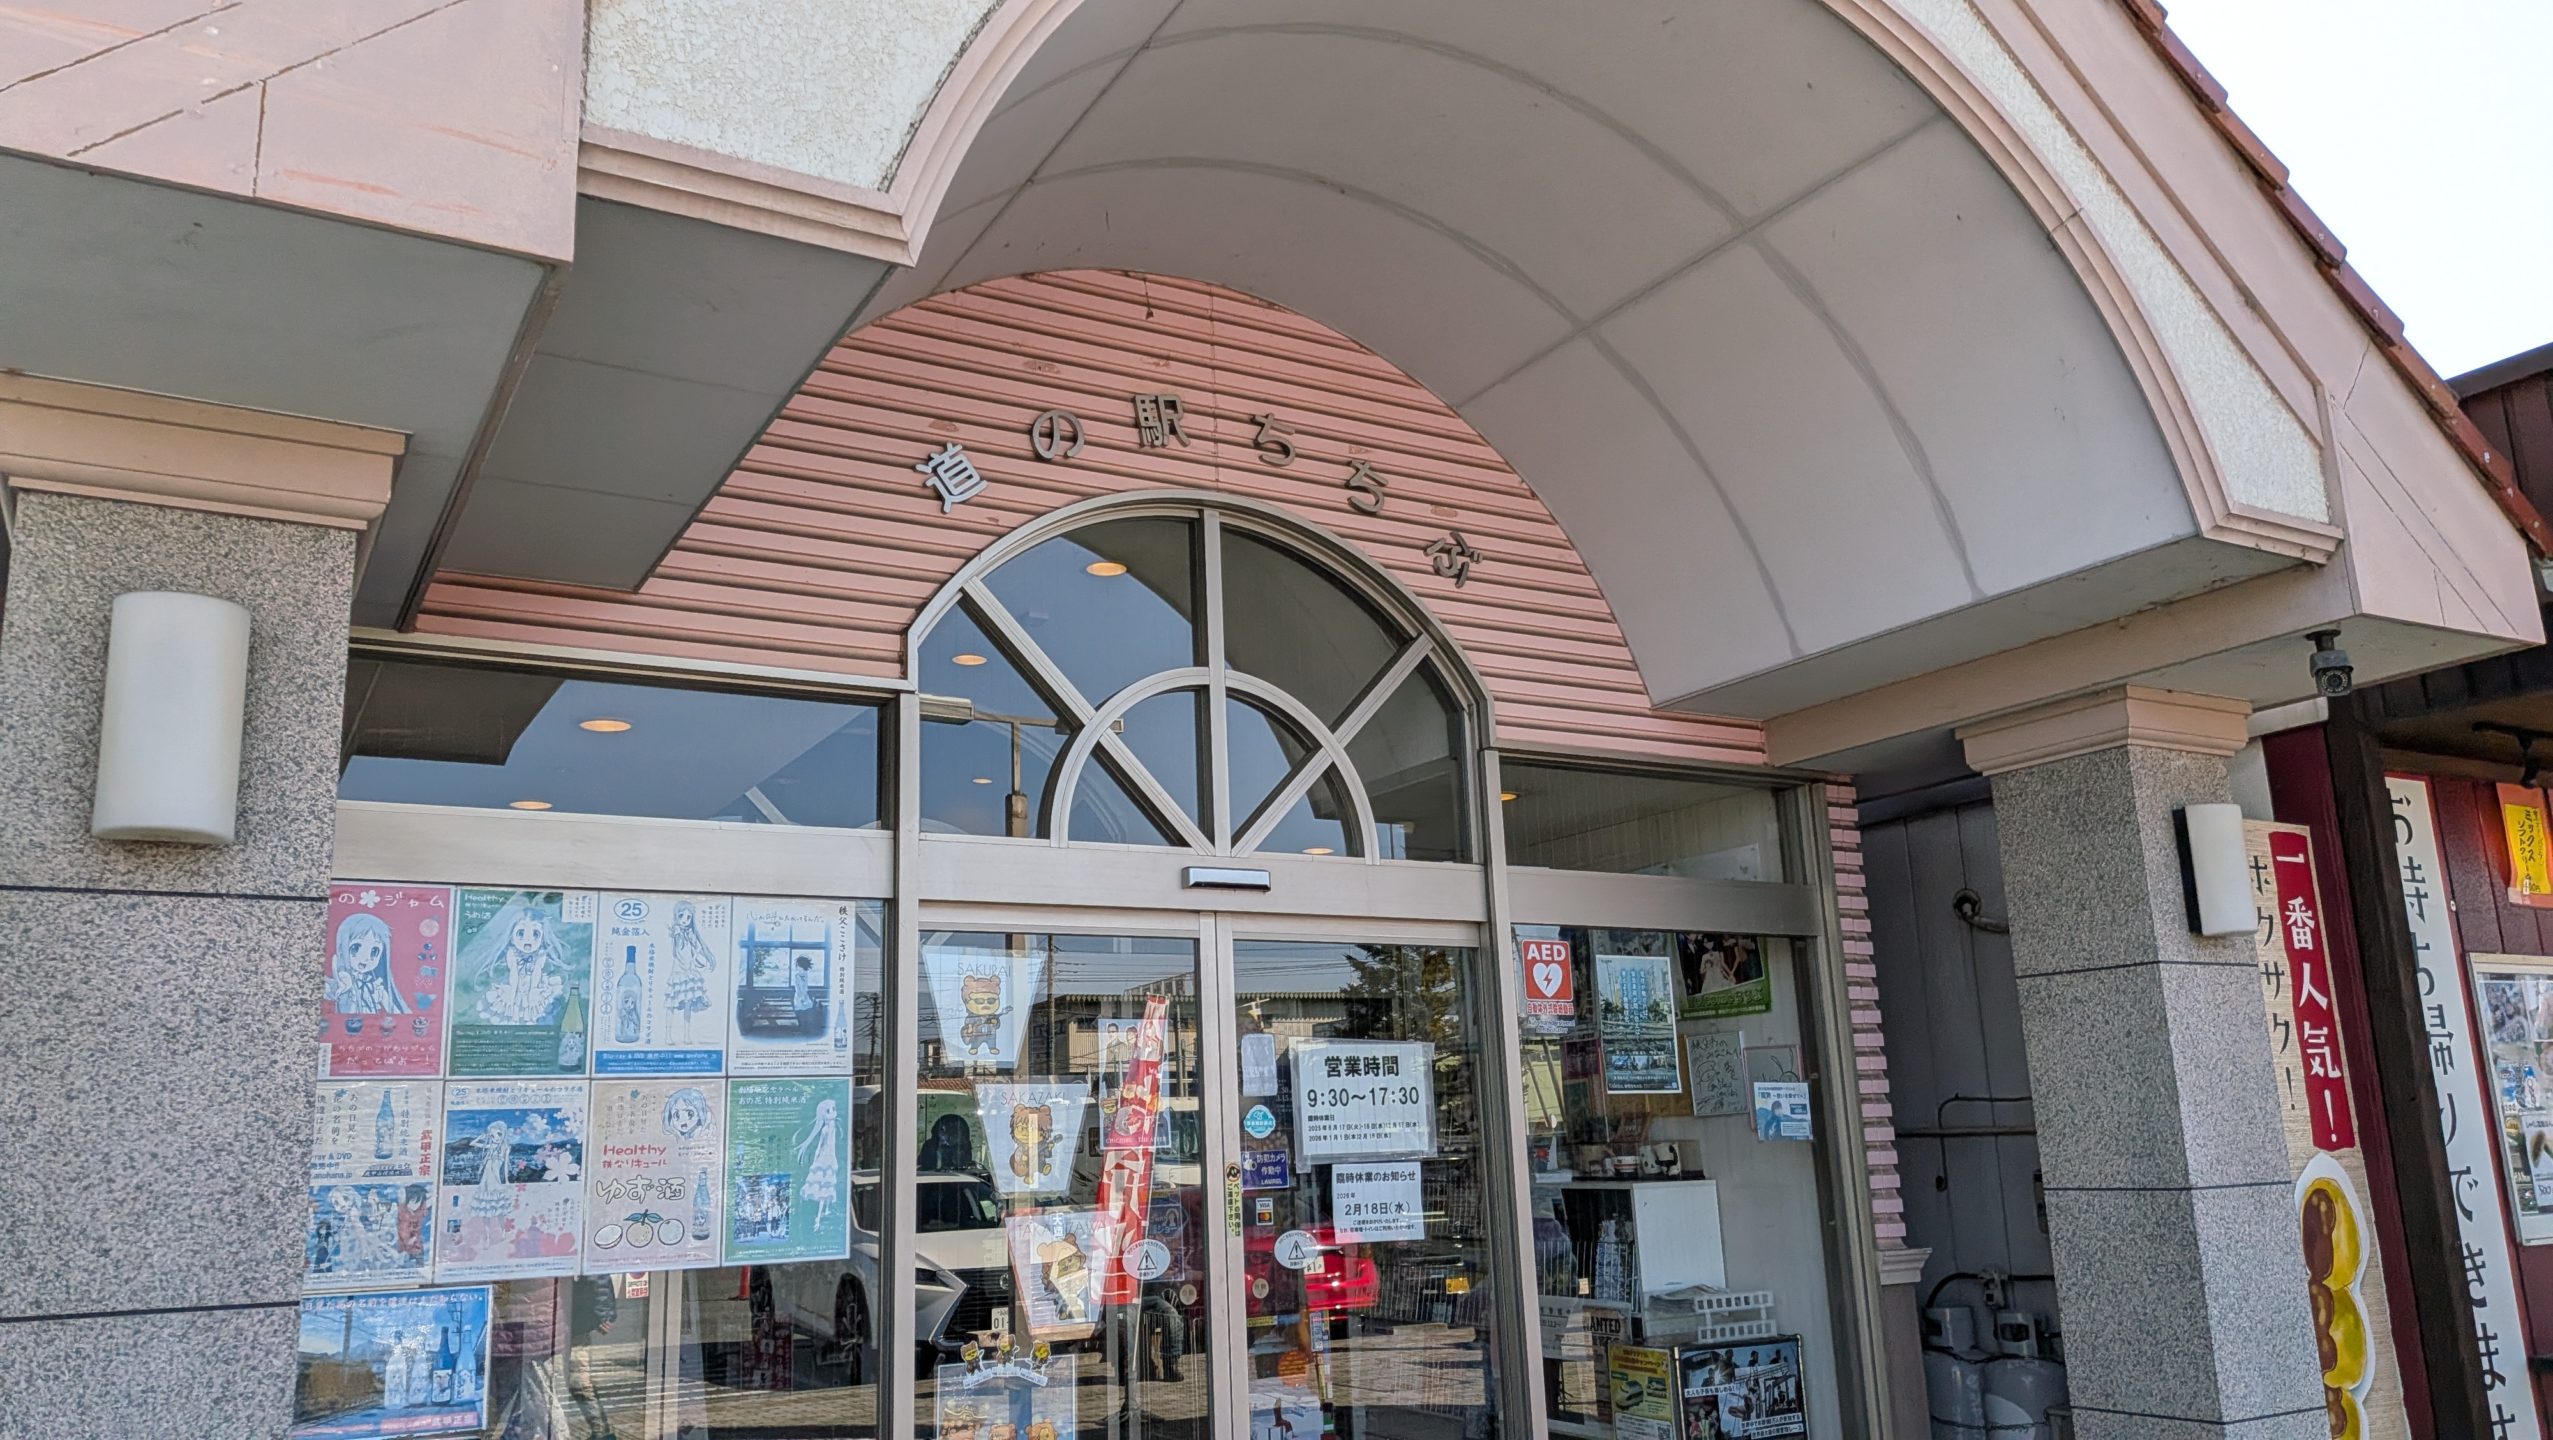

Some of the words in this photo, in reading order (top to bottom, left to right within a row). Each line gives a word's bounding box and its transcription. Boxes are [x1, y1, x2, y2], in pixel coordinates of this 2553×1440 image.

[914, 392, 1484, 589] 道の駅ちちぶ
[620, 902, 642, 917] 25
[1526, 943, 1566, 961] AED
[957, 962, 1012, 978] SAKURAI
[2275, 852, 2342, 1144] 一番人気!
[1324, 1055, 1399, 1078] 営業時間
[1000, 1090, 1066, 1106] SAKAZAKI
[1306, 1086, 1420, 1108] 9:30～17:30
[602, 1144, 667, 1156] Healthy
[1256, 1153, 1287, 1165] 防犯カメラ
[1260, 1166, 1282, 1176] 作動中
[1335, 1170, 1416, 1184] 臨時休業のお知らせ
[595, 1174, 686, 1205] ゆず酒
[1233, 1183, 1241, 1237] ペットの同伴は
[1344, 1200, 1411, 1217] 2月18日(水)
[1582, 1316, 1621, 1334] WANTED
